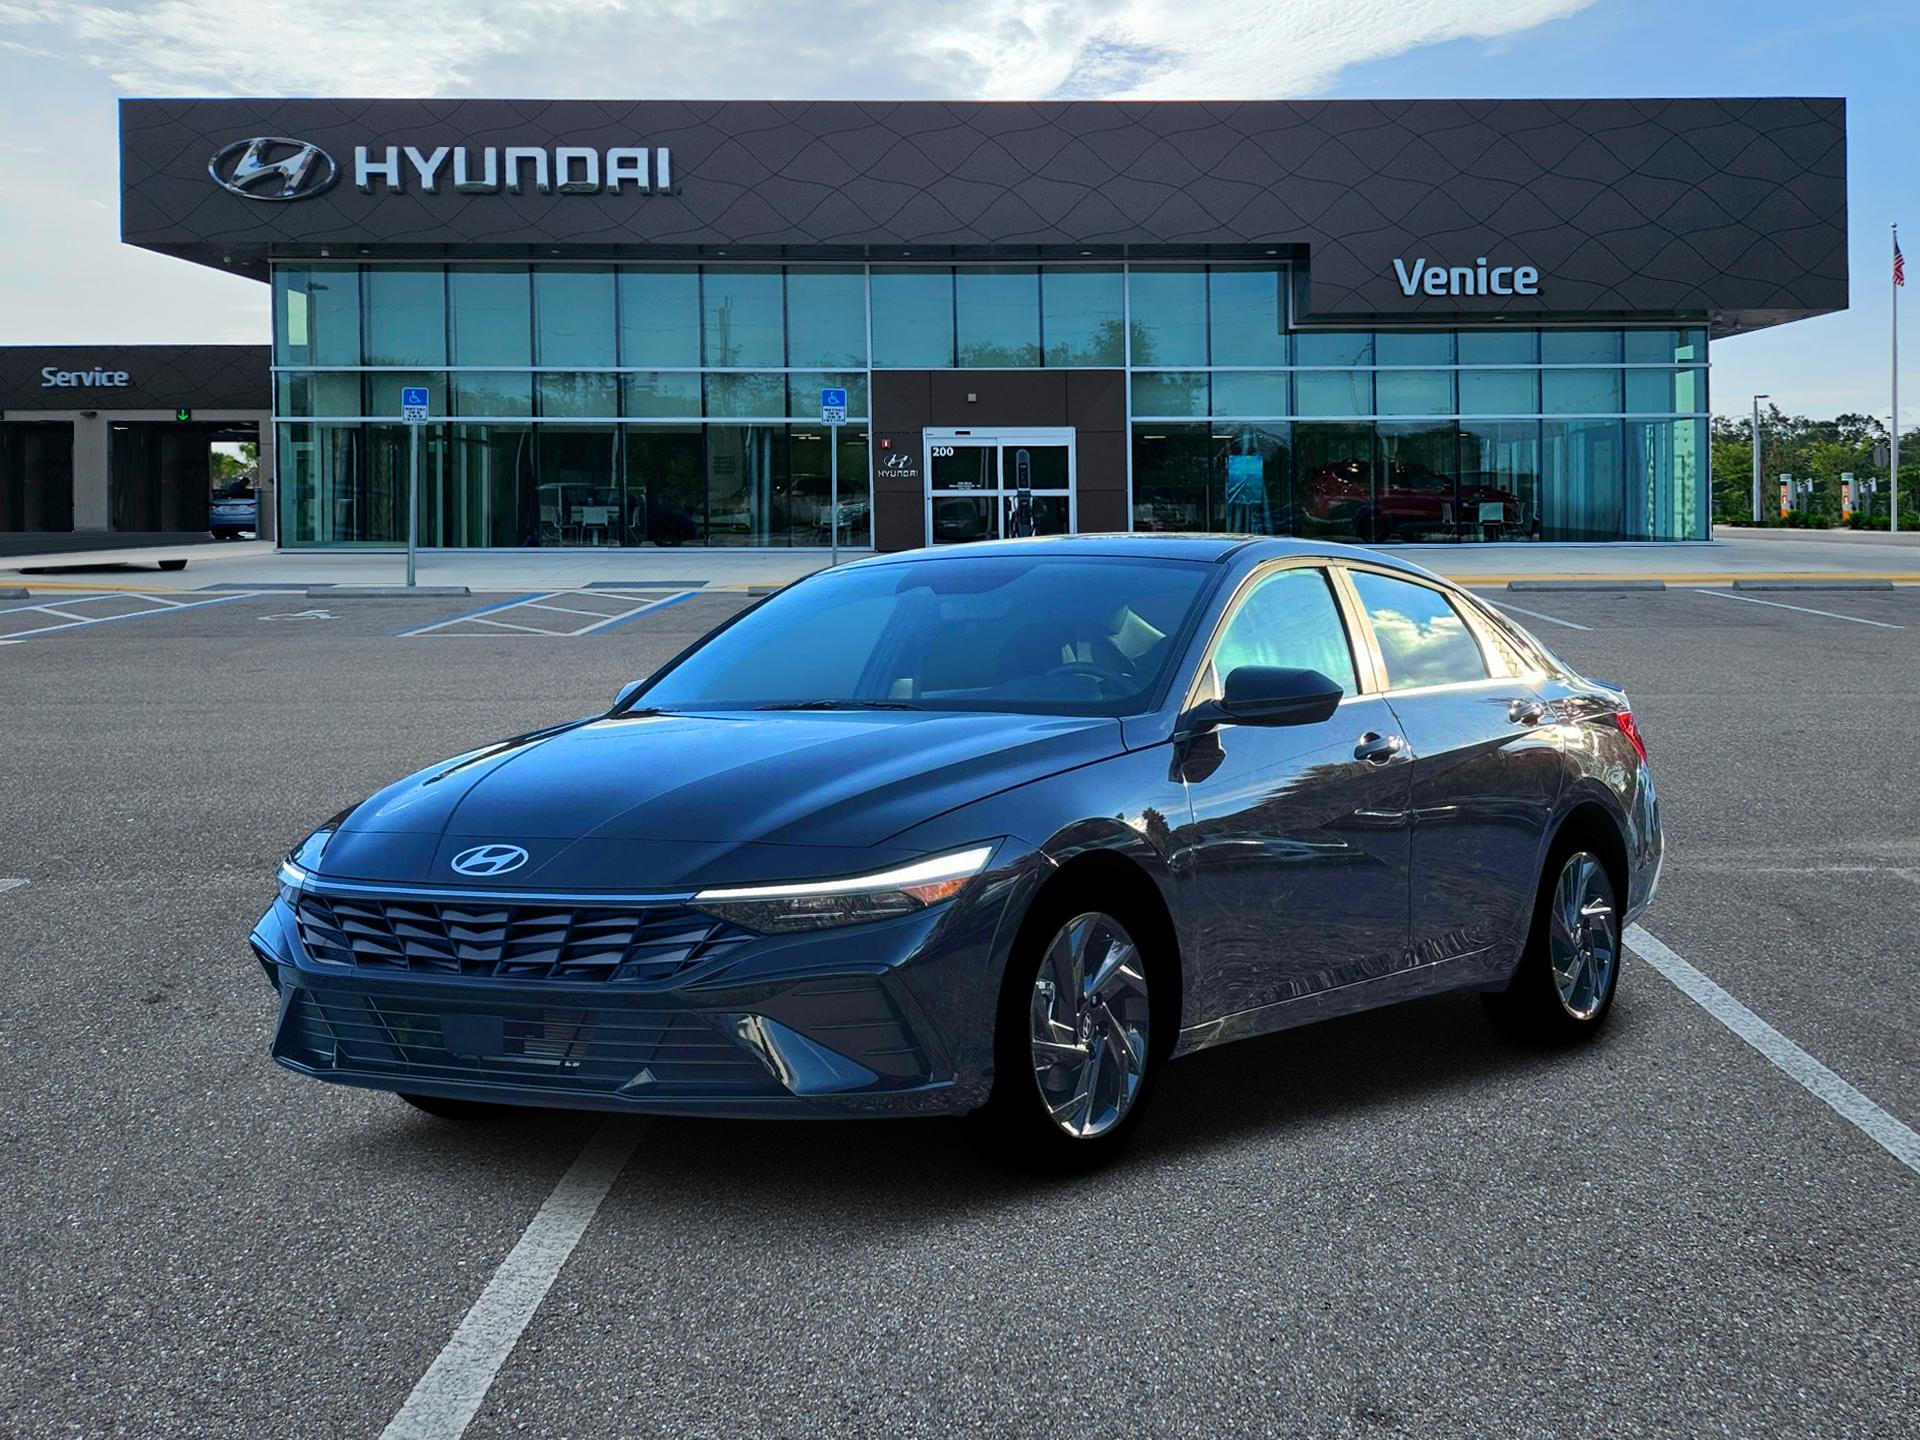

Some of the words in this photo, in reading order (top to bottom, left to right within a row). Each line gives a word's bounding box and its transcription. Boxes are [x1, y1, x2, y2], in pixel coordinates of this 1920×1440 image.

[354, 146, 669, 195] HYUNDAI
[1393, 257, 1539, 296] Venice
[41, 367, 129, 387] Service
[932, 447, 954, 457] 200
[878, 470, 918, 478] HYUNDAI
